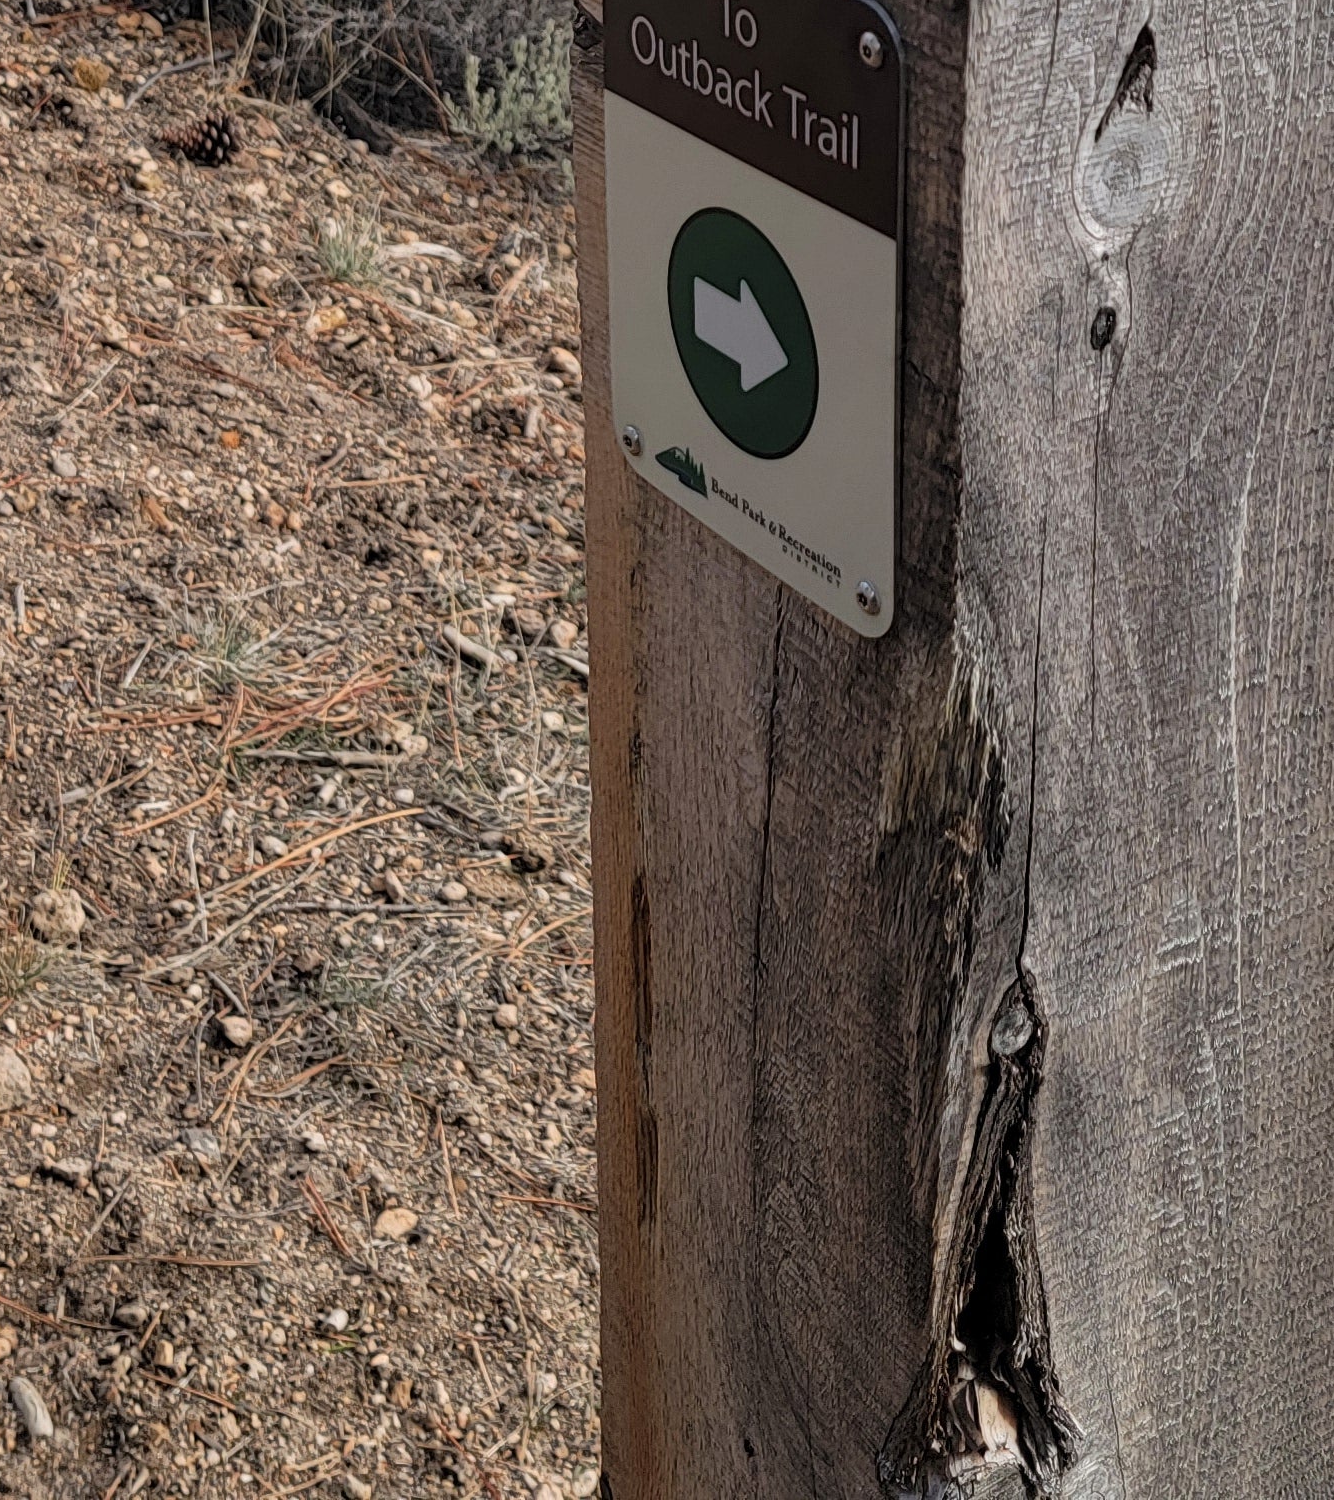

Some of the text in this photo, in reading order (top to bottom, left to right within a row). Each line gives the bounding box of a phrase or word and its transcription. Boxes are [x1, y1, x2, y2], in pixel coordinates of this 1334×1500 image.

[631, 15, 859, 170] Outback Trail
[711, 477, 842, 579] Bend Park & Recreation
